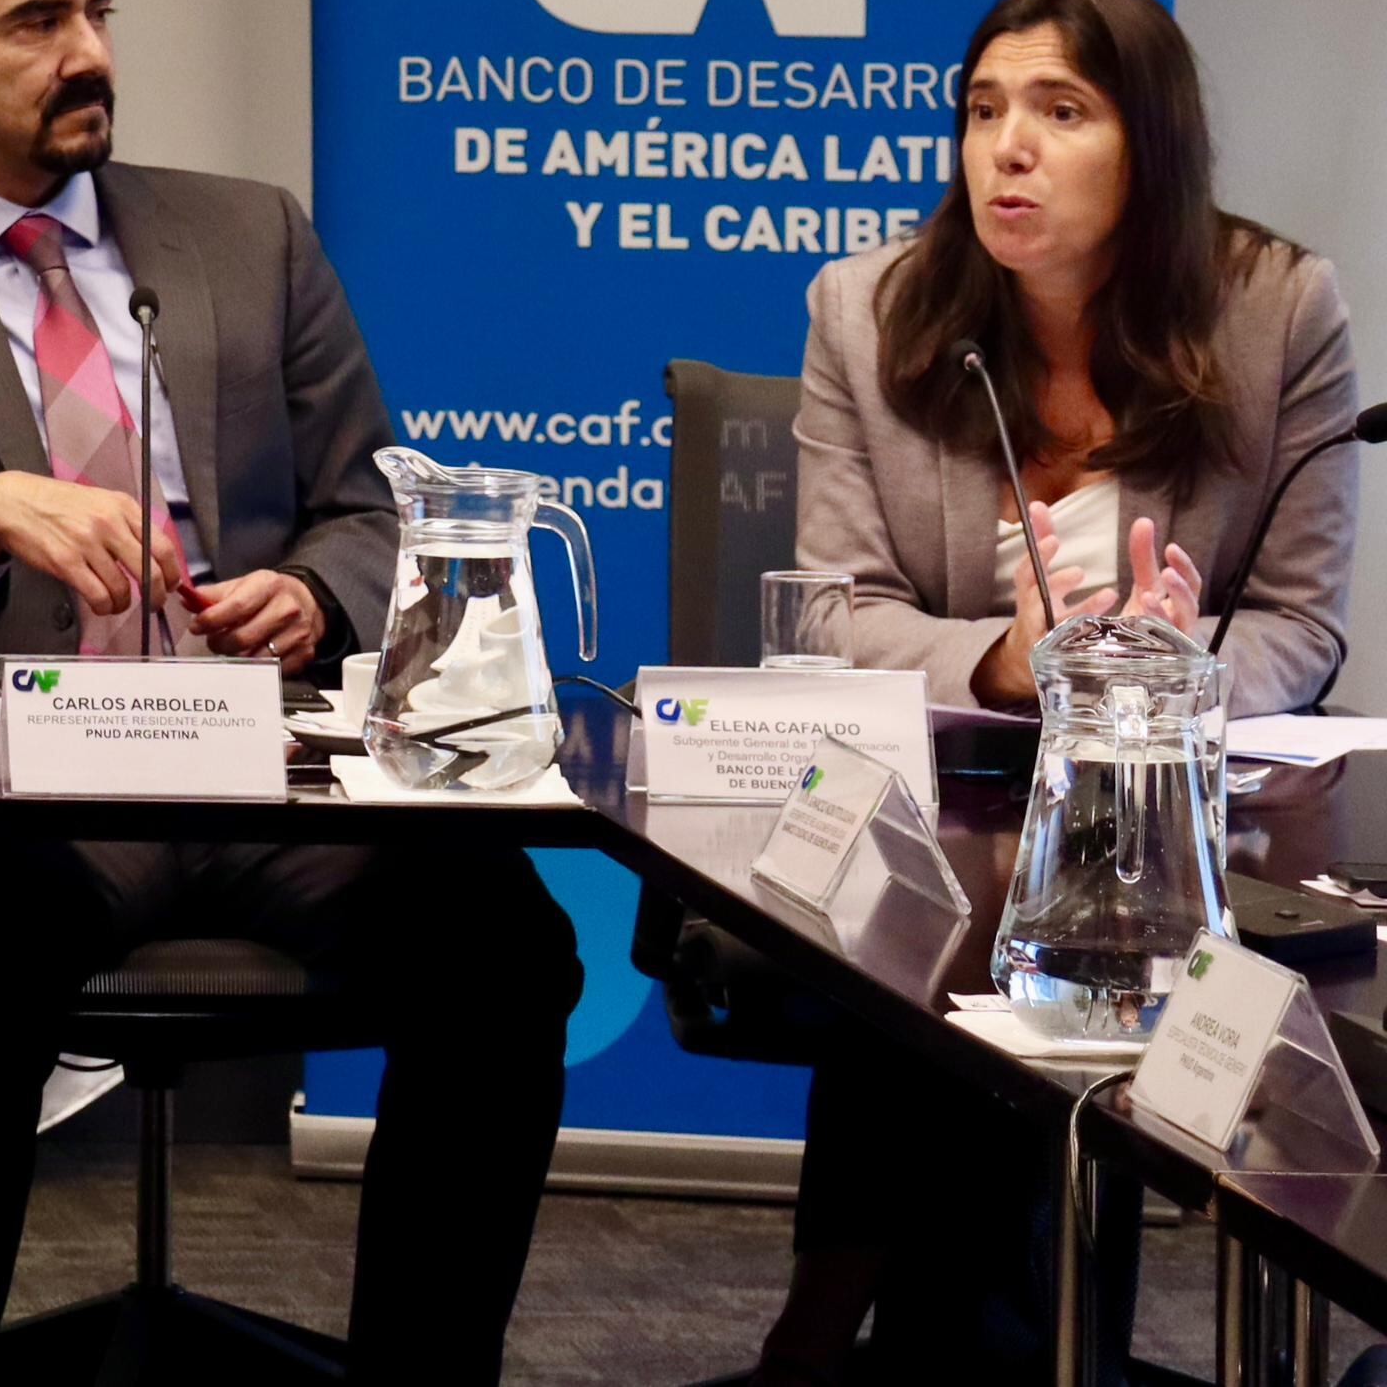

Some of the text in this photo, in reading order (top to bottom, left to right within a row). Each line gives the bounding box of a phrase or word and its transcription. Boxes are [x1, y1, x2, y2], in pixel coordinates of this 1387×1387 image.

[399, 56, 963, 110] BANCO DE DESARRO
[455, 116, 952, 183] DE AMÉRICA LATI
[565, 201, 920, 254] Y EL CARIBE
[12, 670, 61, 693] CAF
[53, 697, 228, 712] CARLOS ARBOLEDA
[656, 698, 709, 725] CAF
[27, 715, 256, 727] REPRESENTANTE RESIDENTE ADJUNTO
[711, 720, 770, 733] ELENA
[86, 729, 199, 740] PNUD ARGENTINA
[673, 735, 739, 749] Subgerente
[744, 737, 789, 749] General
[794, 738, 807, 750] de
[718, 751, 777, 762] Desarrollo
[717, 765, 764, 775] BANCO
[768, 765, 785, 776] DE
[729, 779, 797, 790] DE BUENO
